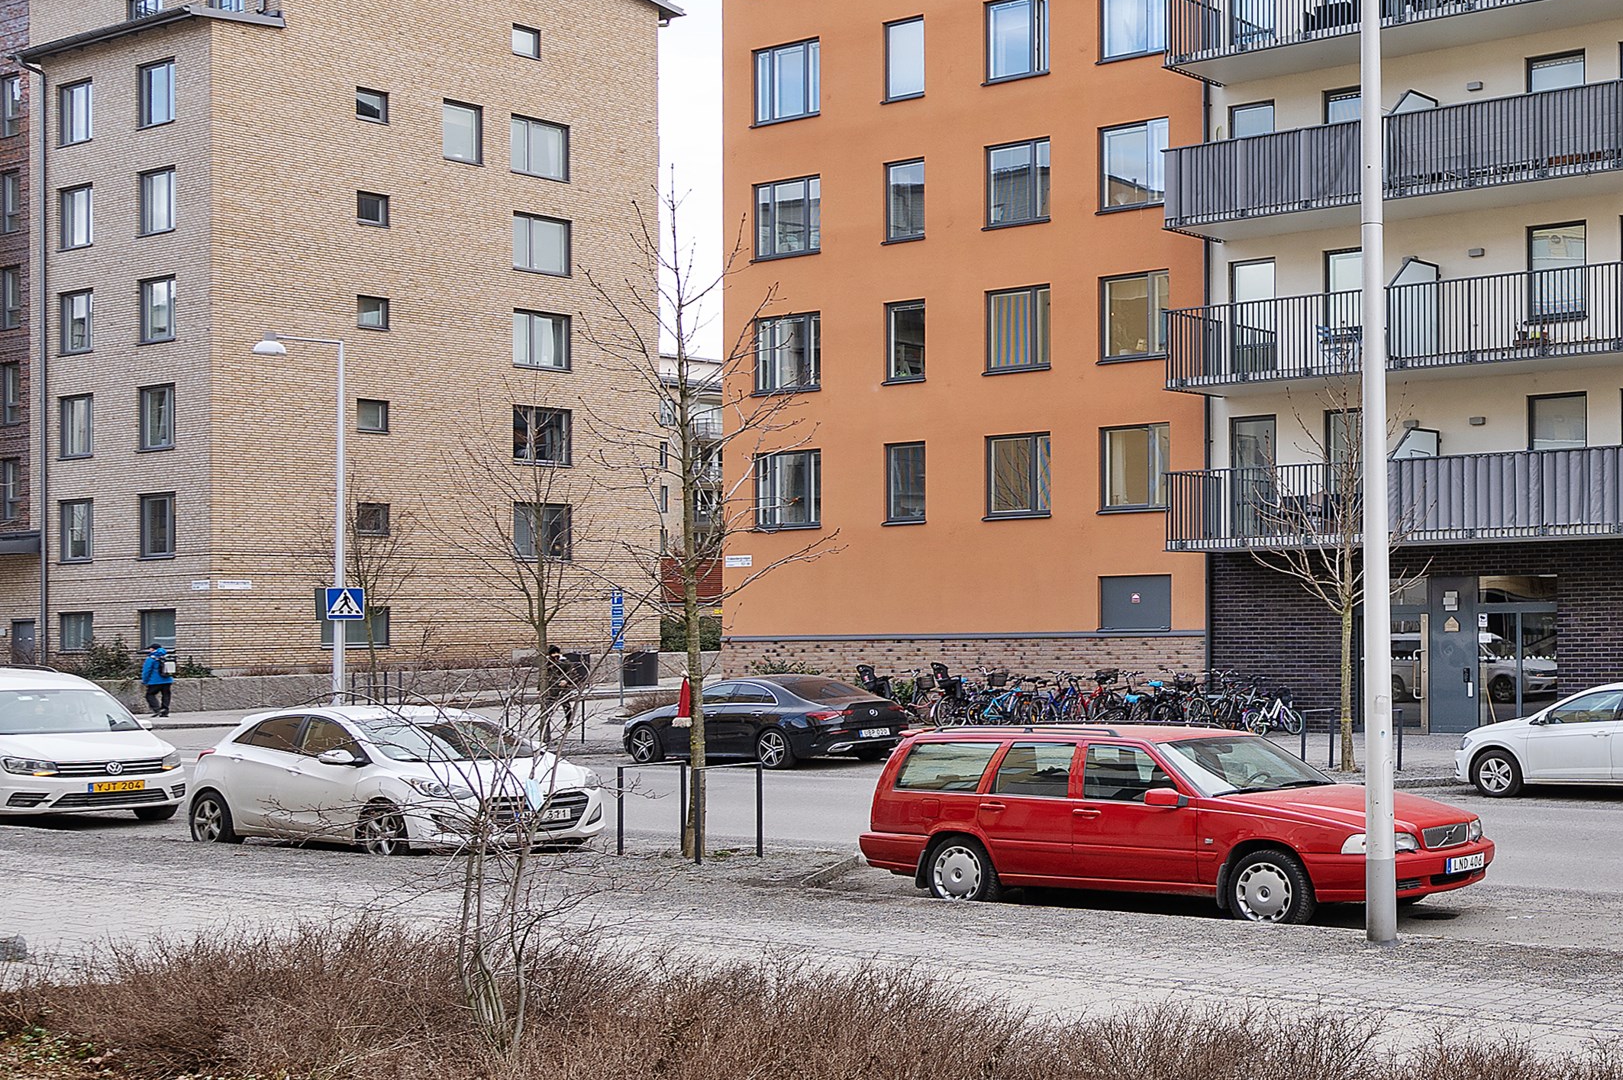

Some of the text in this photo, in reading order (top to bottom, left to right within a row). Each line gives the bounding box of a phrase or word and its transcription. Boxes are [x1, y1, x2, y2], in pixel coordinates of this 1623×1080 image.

[97, 781, 141, 791] YJT 204
[1454, 854, 1483, 871] LND 406
